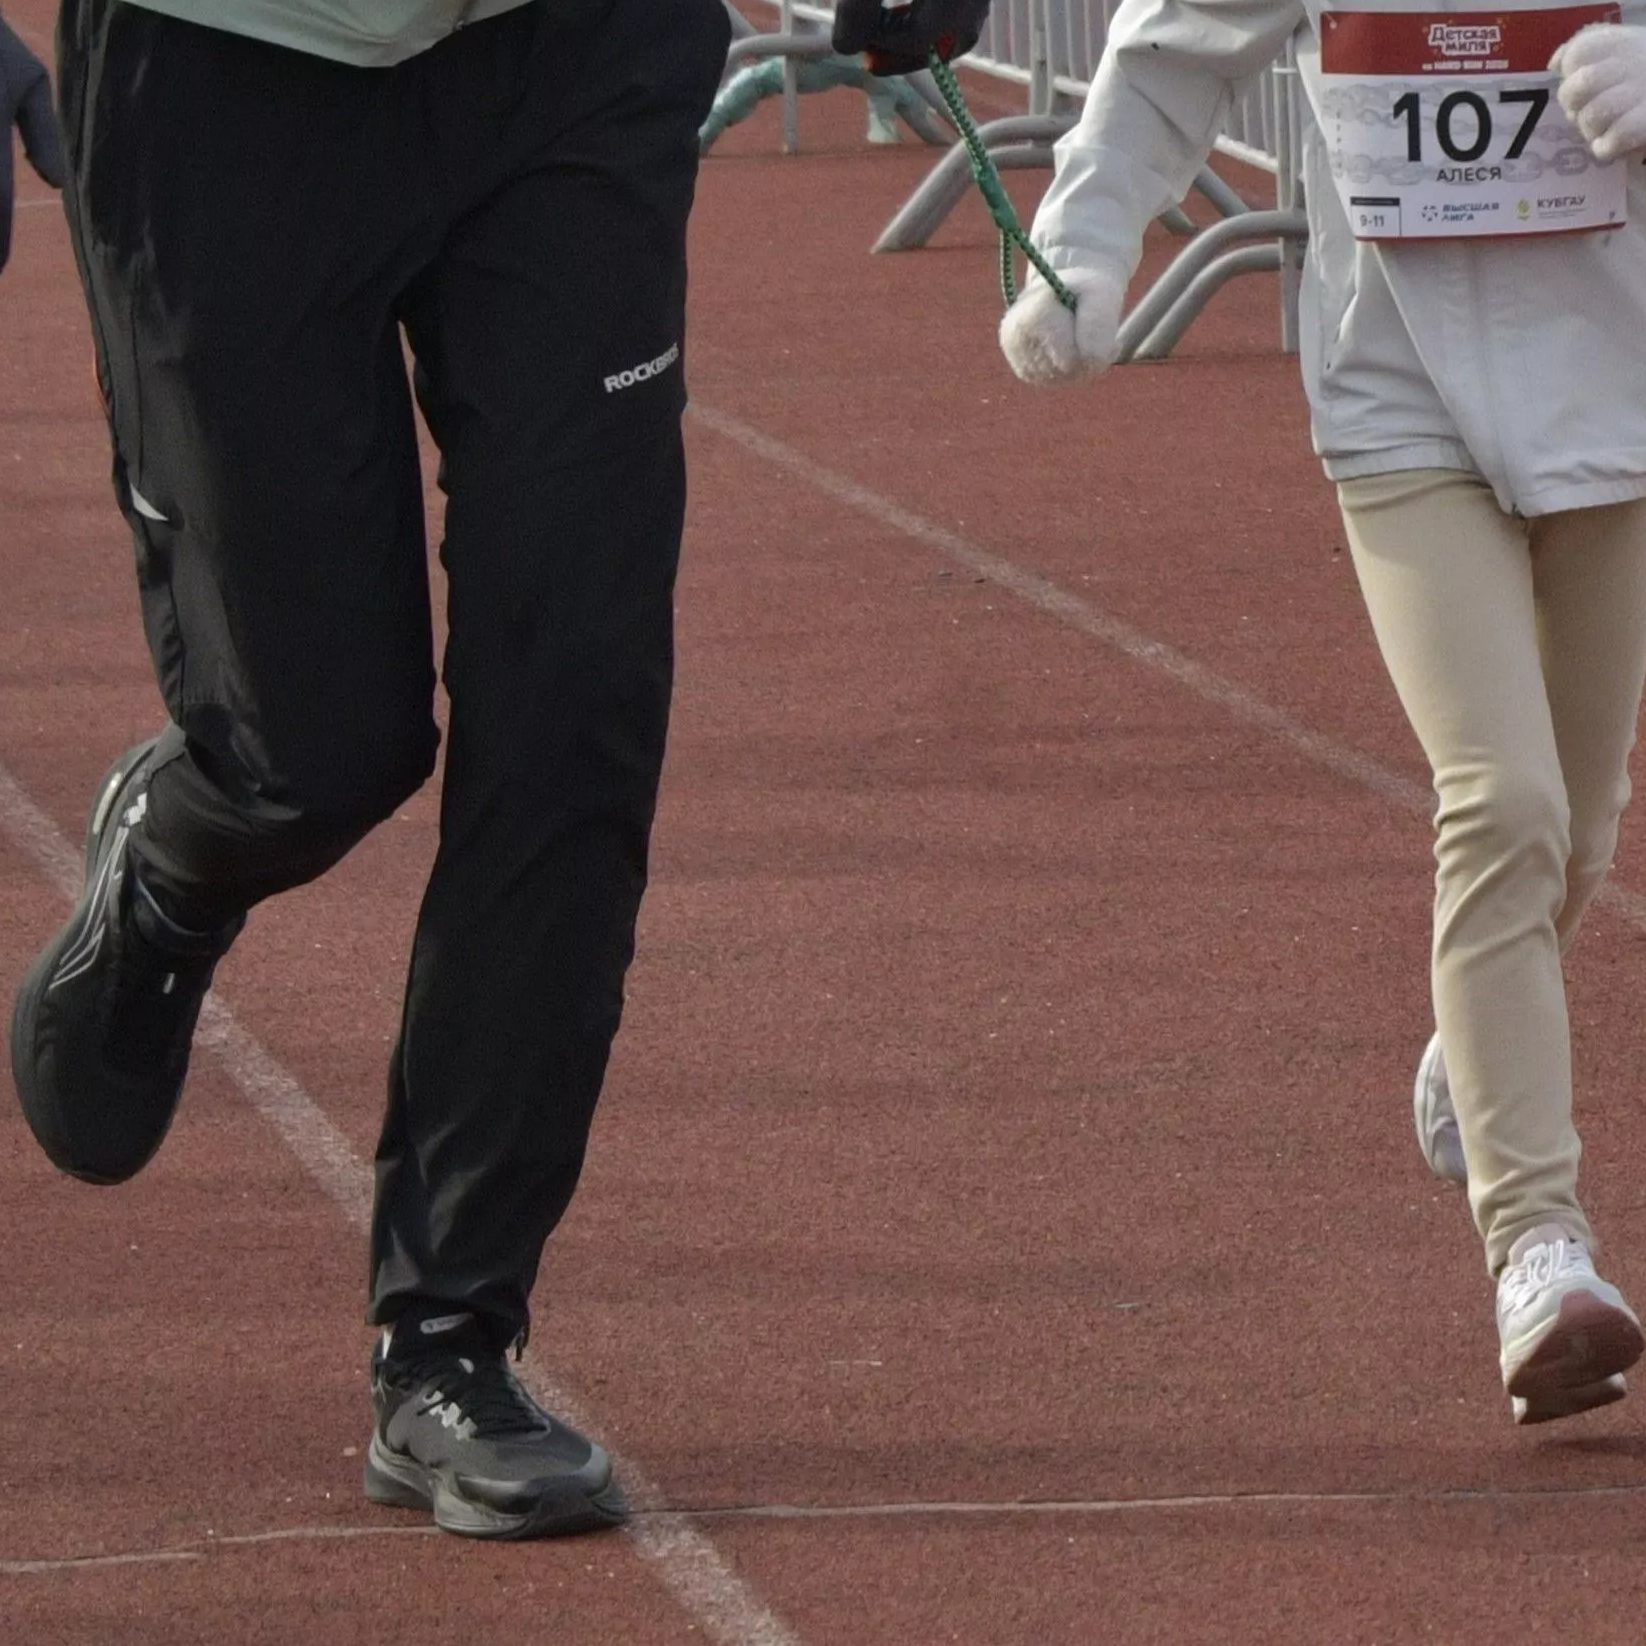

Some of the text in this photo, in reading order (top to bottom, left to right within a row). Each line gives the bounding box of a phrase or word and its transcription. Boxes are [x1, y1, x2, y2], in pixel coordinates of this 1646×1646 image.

[1392, 87, 1550, 163] 107
[1436, 166, 1502, 183] АЛЕСЯ
[1442, 202, 1500, 213] ВЫСШАЯ
[1359, 214, 1385, 228] 9-11
